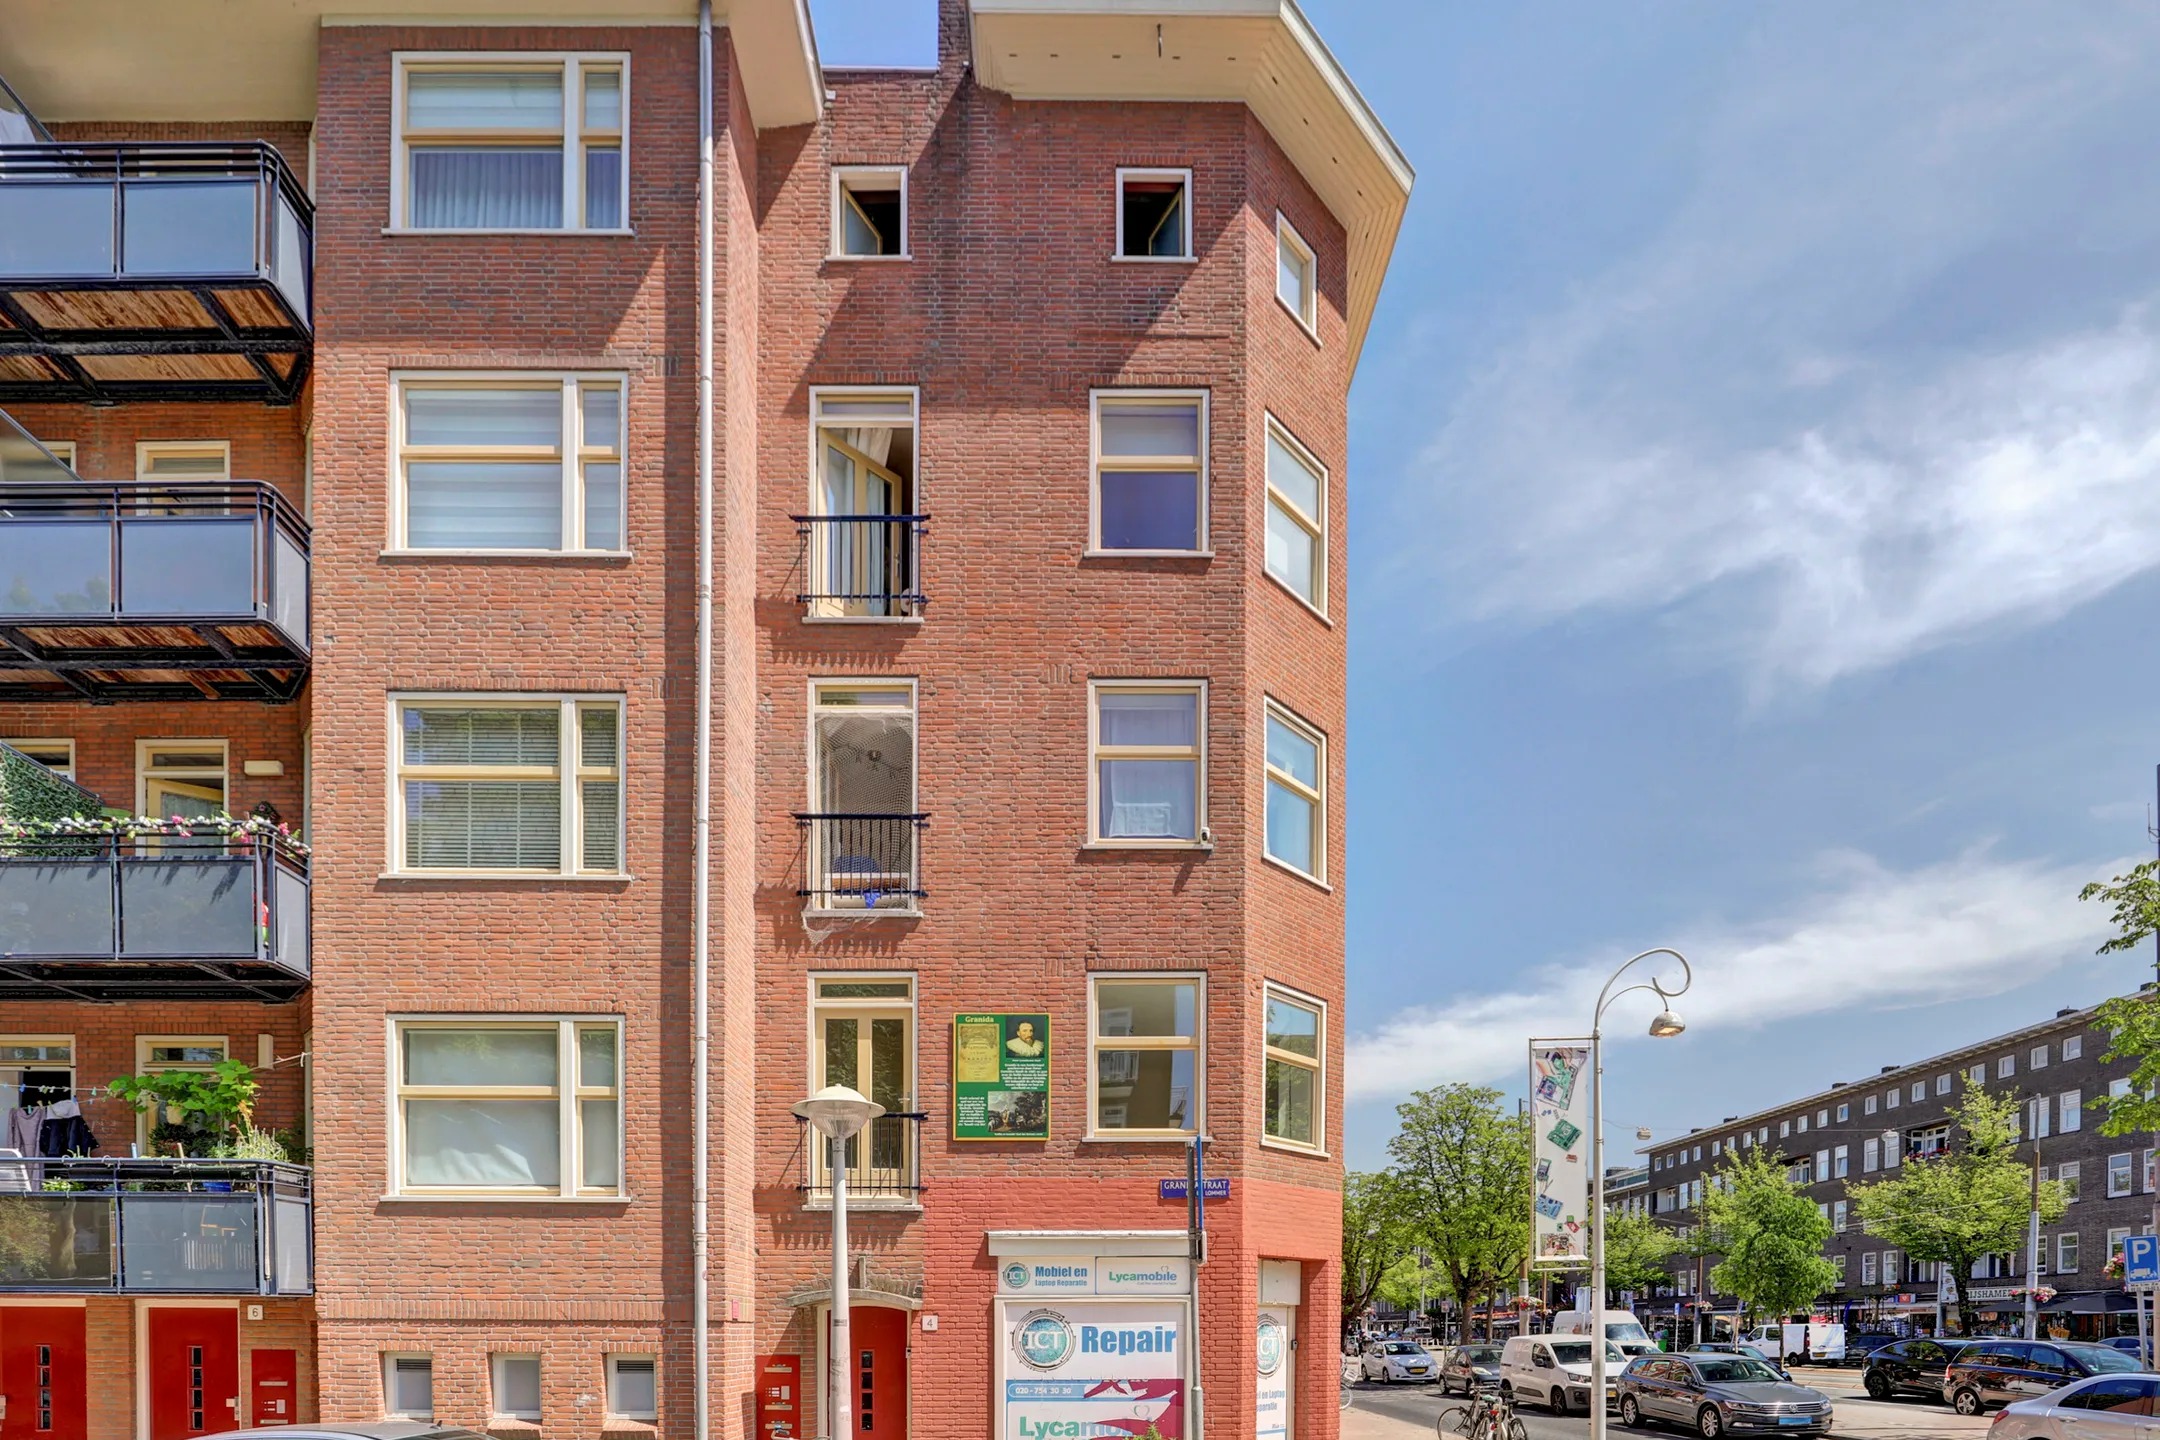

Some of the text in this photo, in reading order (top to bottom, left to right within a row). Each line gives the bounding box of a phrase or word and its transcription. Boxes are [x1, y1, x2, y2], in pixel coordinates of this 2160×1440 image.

[1164, 1181, 1226, 1189] GRANIATRAAT
[2132, 1240, 2151, 1263] P
[1009, 1271, 1025, 1279] ICT
[1035, 1266, 1087, 1277] Mobiel en
[1109, 1271, 1176, 1283] Lycamobile
[252, 1307, 259, 1317] 6
[926, 1318, 933, 1328] 4
[1025, 1331, 1064, 1350] ICT
[1082, 1326, 1176, 1355] Repair
